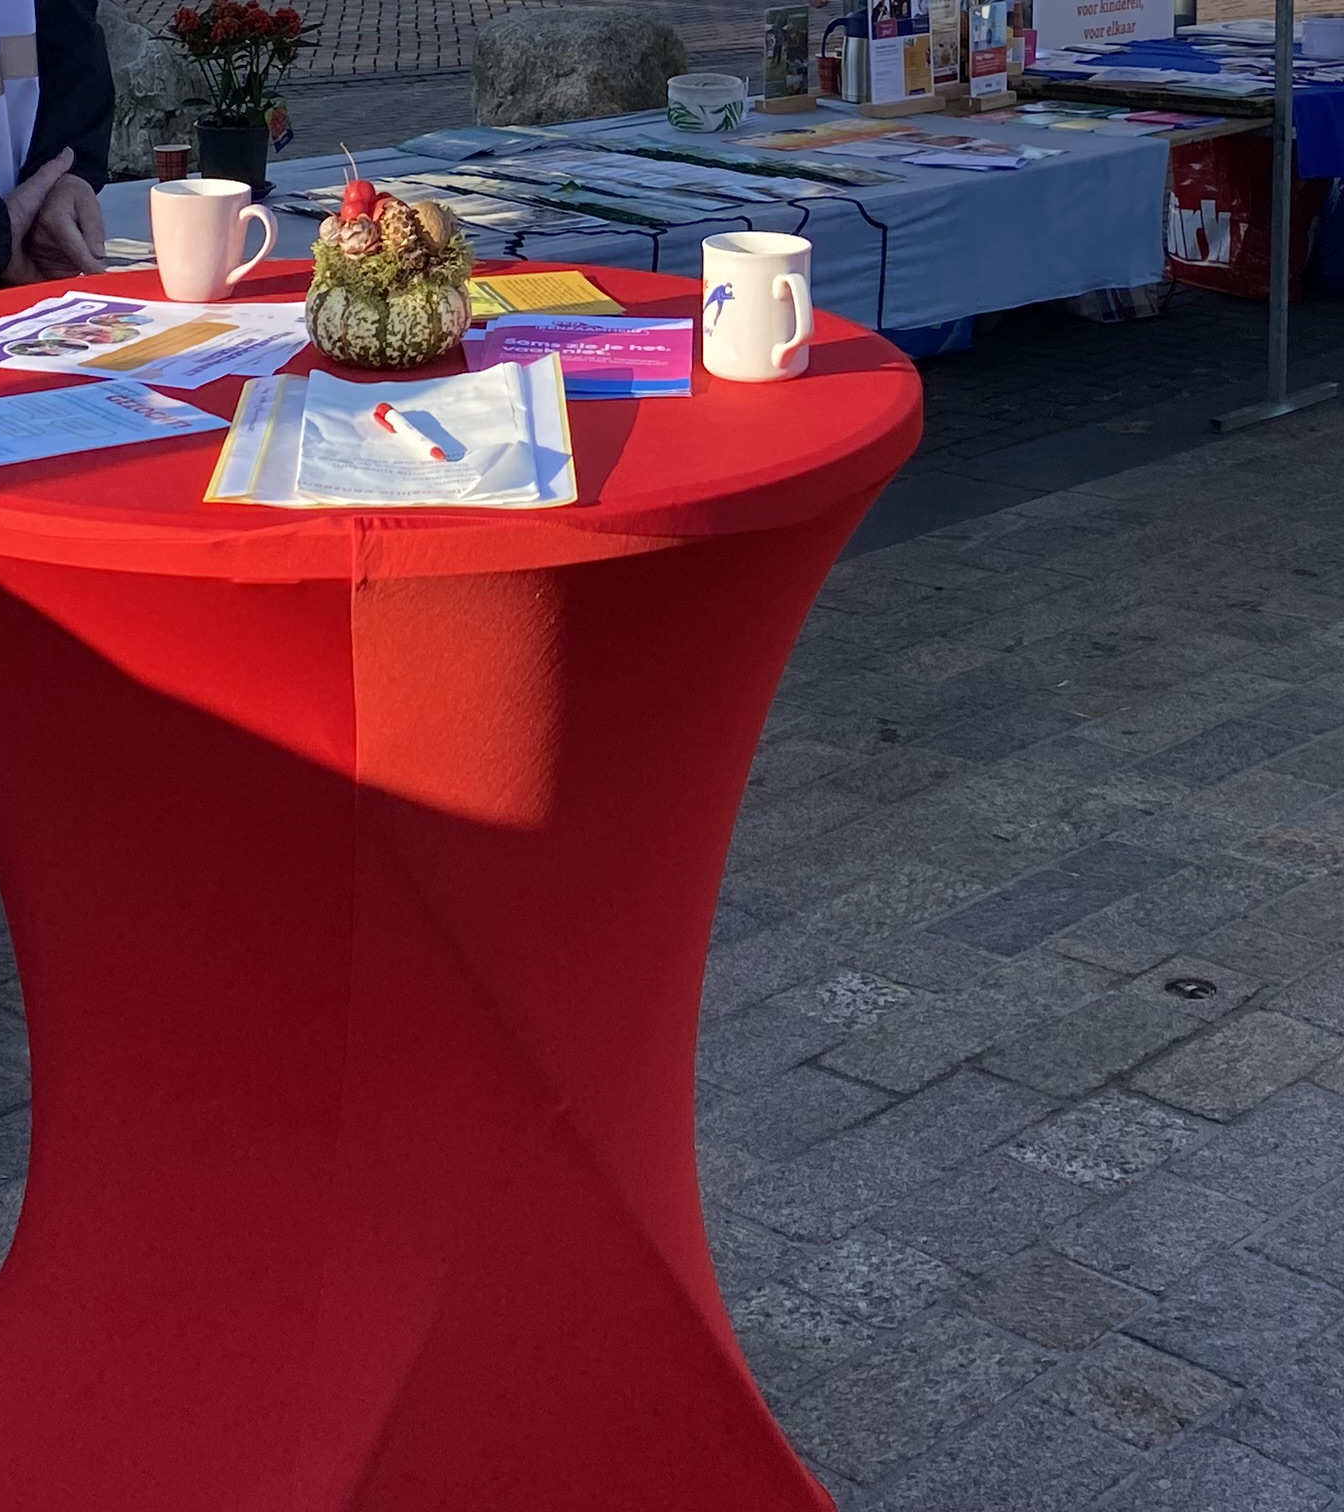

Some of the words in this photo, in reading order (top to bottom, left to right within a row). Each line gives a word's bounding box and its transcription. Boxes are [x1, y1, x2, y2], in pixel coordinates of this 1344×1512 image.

[1076, 4, 1098, 17] voor
[1084, 27, 1104, 40] voor
[1106, 21, 1136, 37] elkaar
[503, 346, 556, 354] vaak
[505, 338, 560, 348] Soms
[566, 342, 598, 350] zie
[600, 343, 625, 355] je
